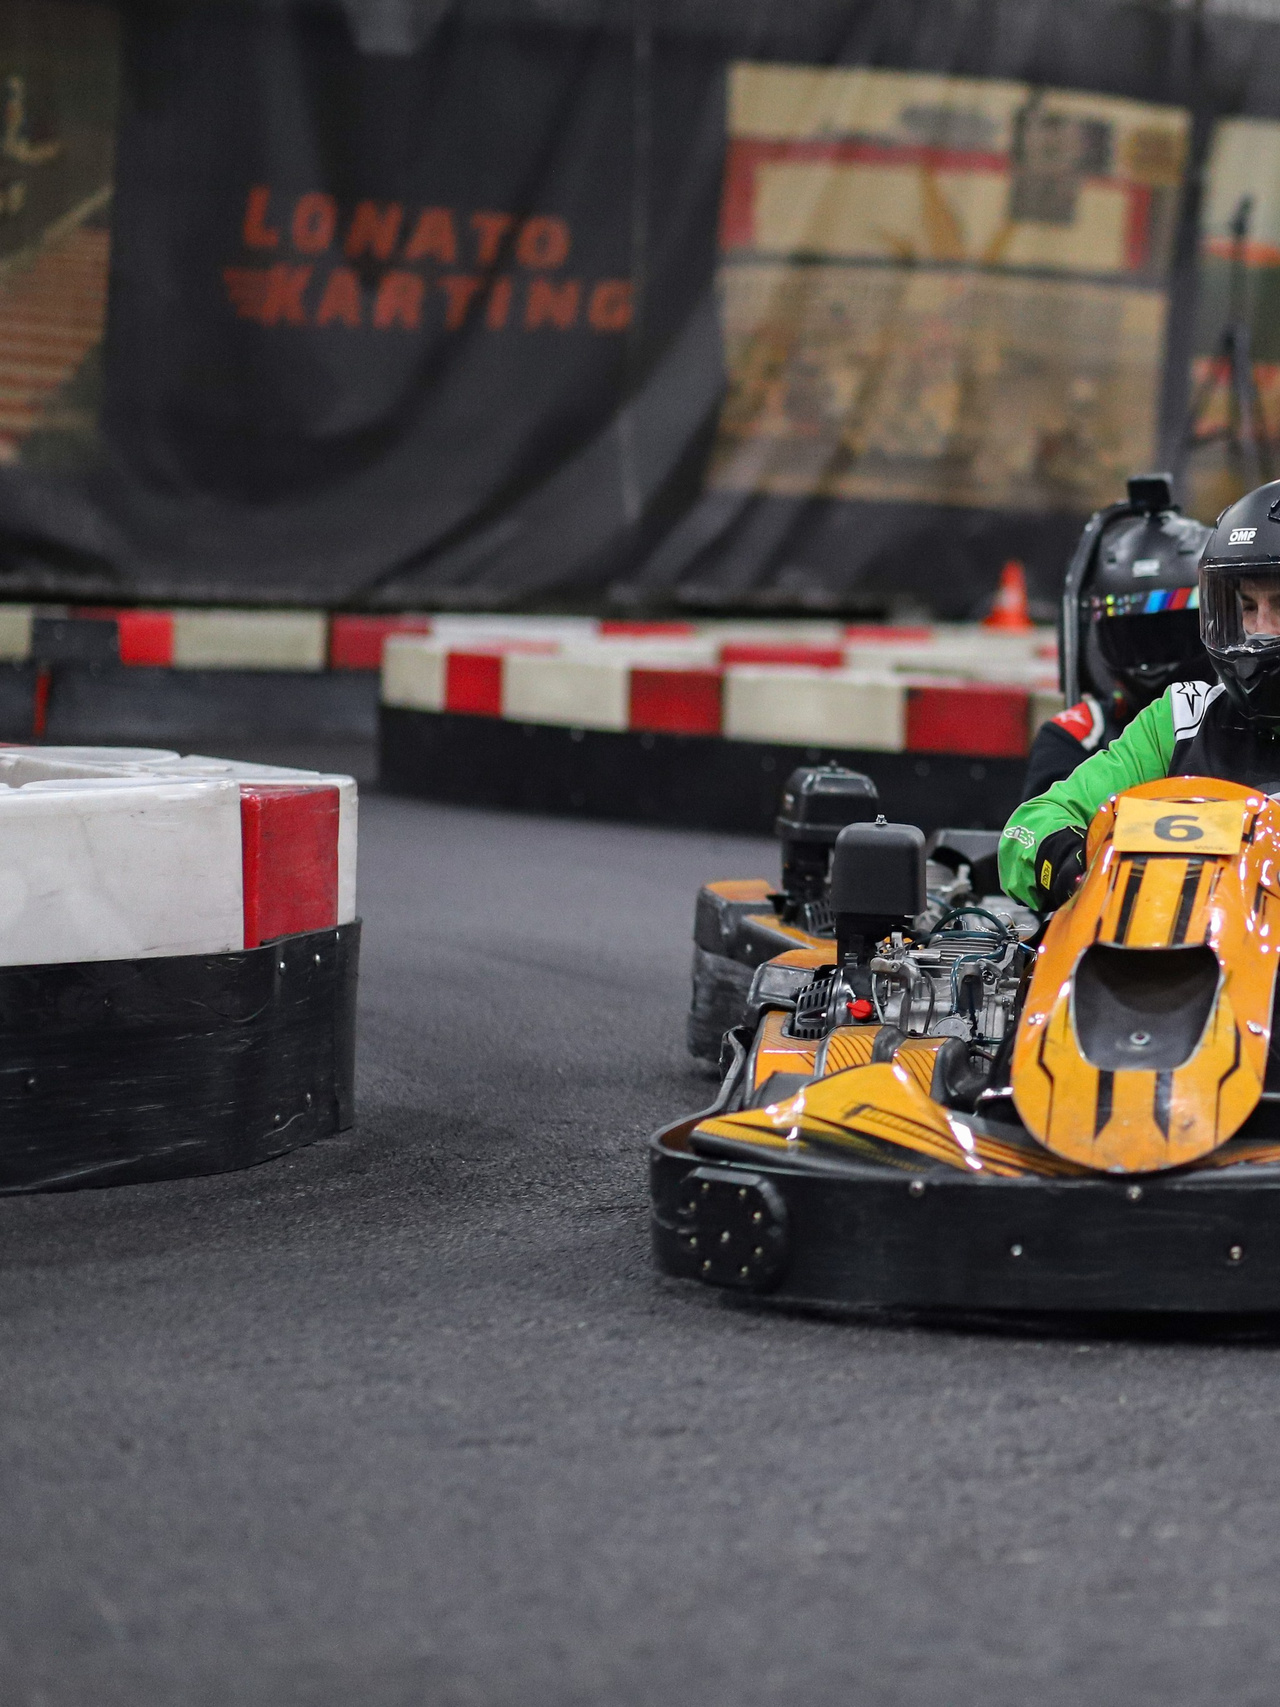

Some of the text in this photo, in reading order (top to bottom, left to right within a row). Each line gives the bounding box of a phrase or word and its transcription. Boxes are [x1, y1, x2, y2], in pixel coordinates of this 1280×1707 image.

[242, 185, 575, 270] LONATO
[250, 264, 636, 333] KARTING
[1229, 530, 1256, 542] OMP
[1154, 815, 1204, 842] 6
